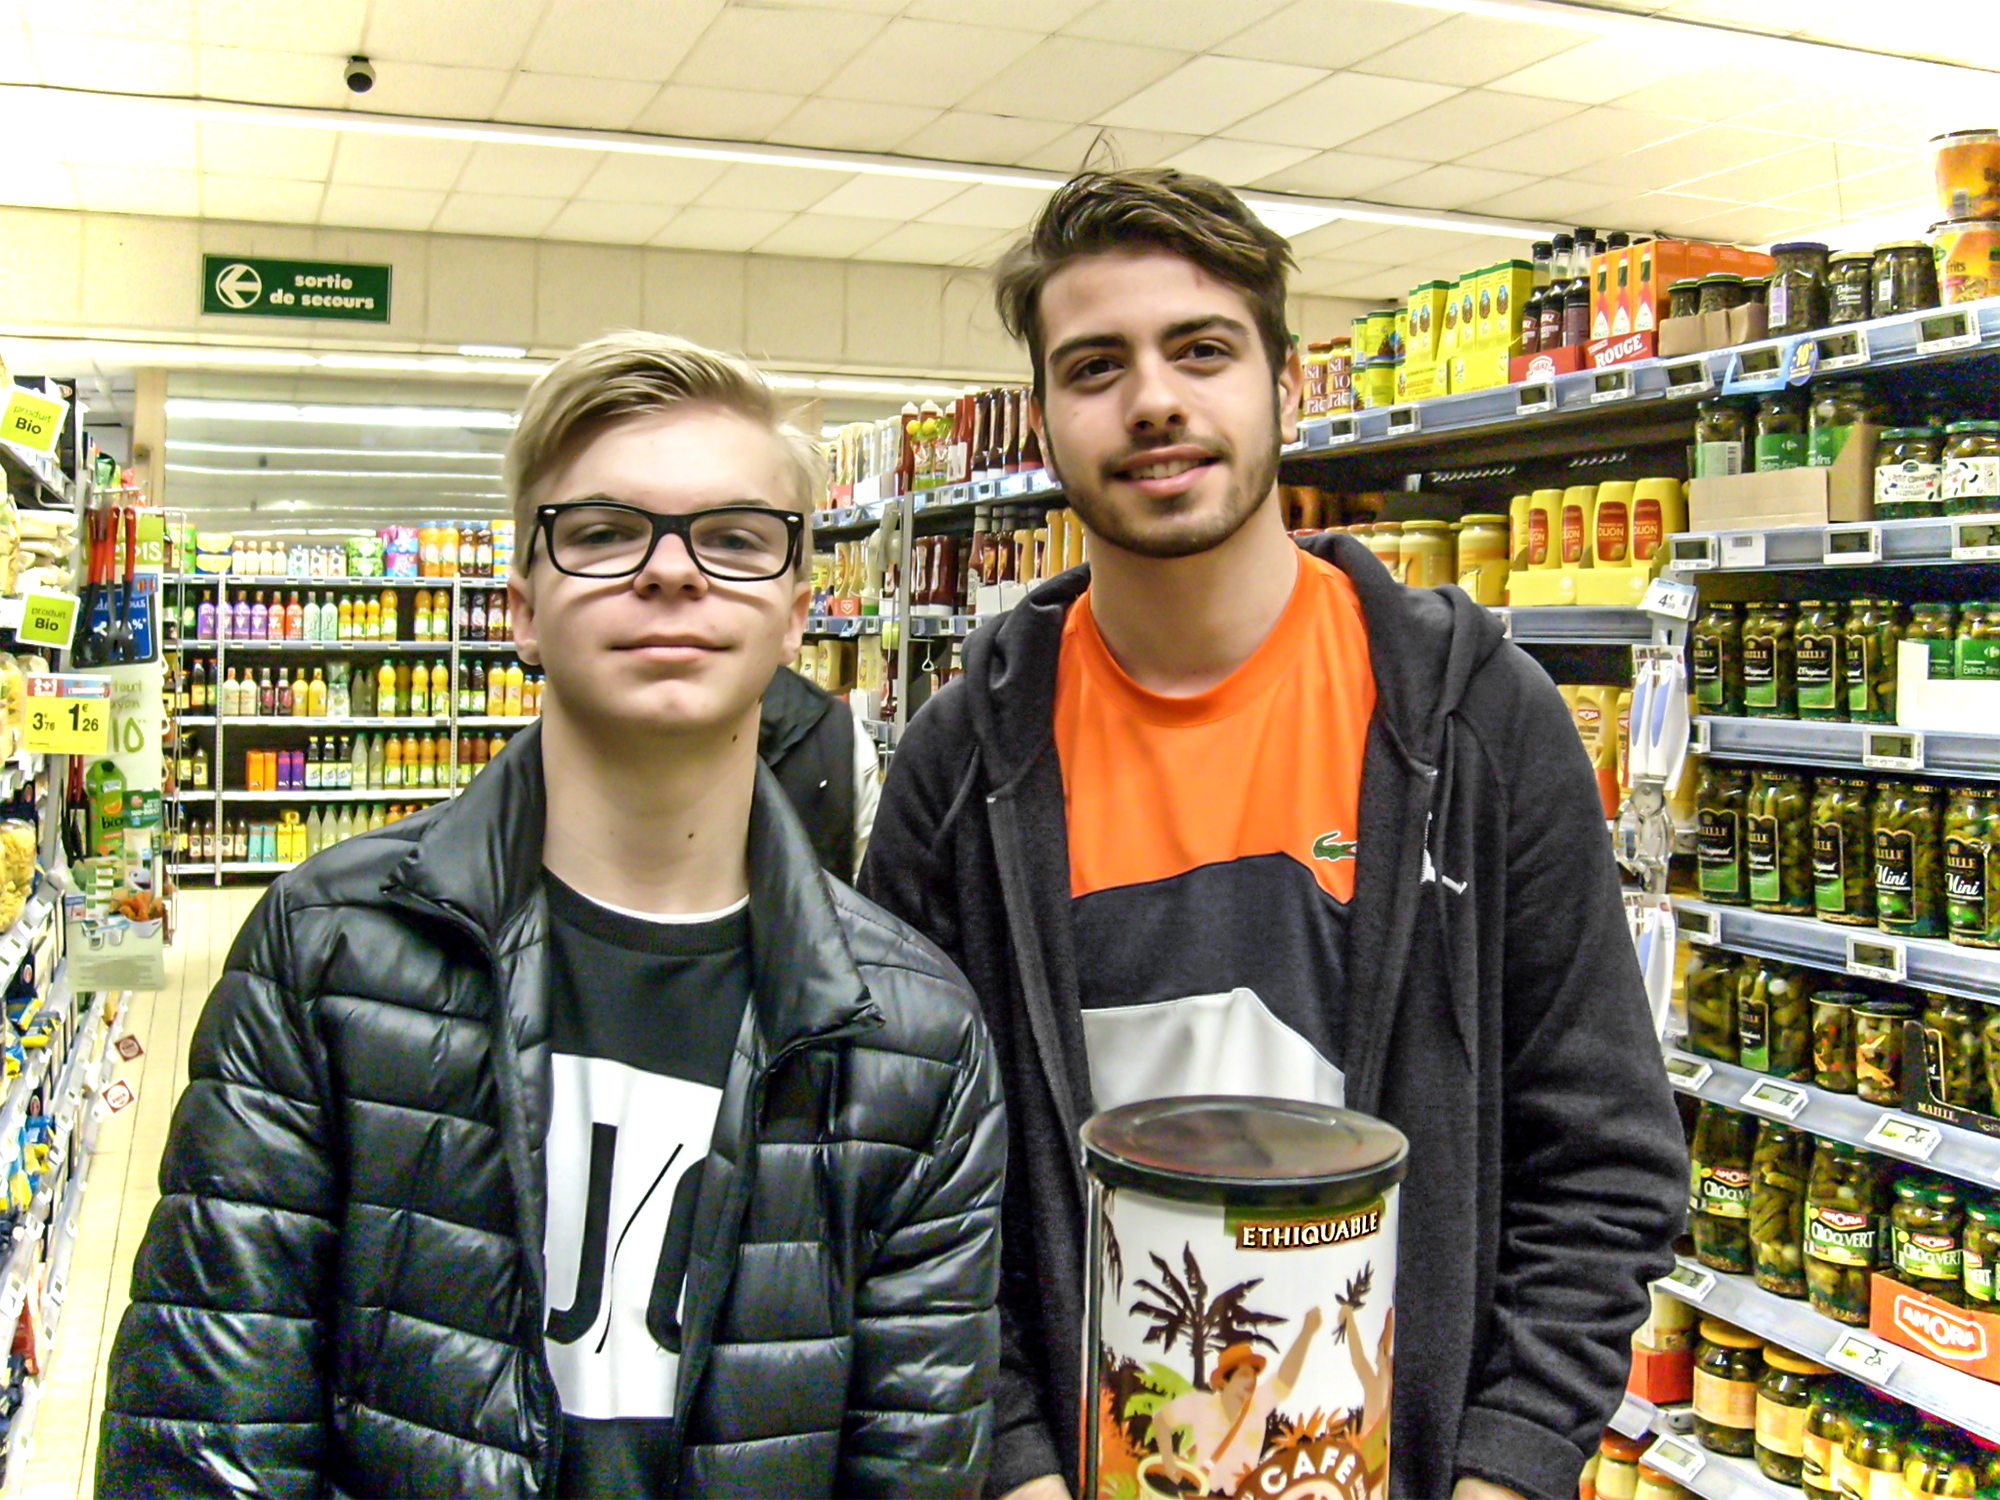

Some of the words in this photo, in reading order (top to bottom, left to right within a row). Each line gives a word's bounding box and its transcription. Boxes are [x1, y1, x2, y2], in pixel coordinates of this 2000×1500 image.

[295, 273, 353, 290] sortie
[269, 289, 295, 305] de
[302, 295, 374, 310] secours
[1594, 333, 1643, 368] ROUGE
[13, 405, 51, 423] produit
[15, 417, 41, 434] Bio
[31, 607, 67, 619] produit
[34, 618, 59, 631] Bio
[102, 816, 122, 829] bio
[1821, 1210, 1863, 1226] AMORA
[1242, 1210, 1379, 1248] ETHIQUABLE
[1914, 1235, 1952, 1248] AMORA
[1902, 1305, 1976, 1347] AMORA
[1260, 1446, 1357, 1494] CAFE
